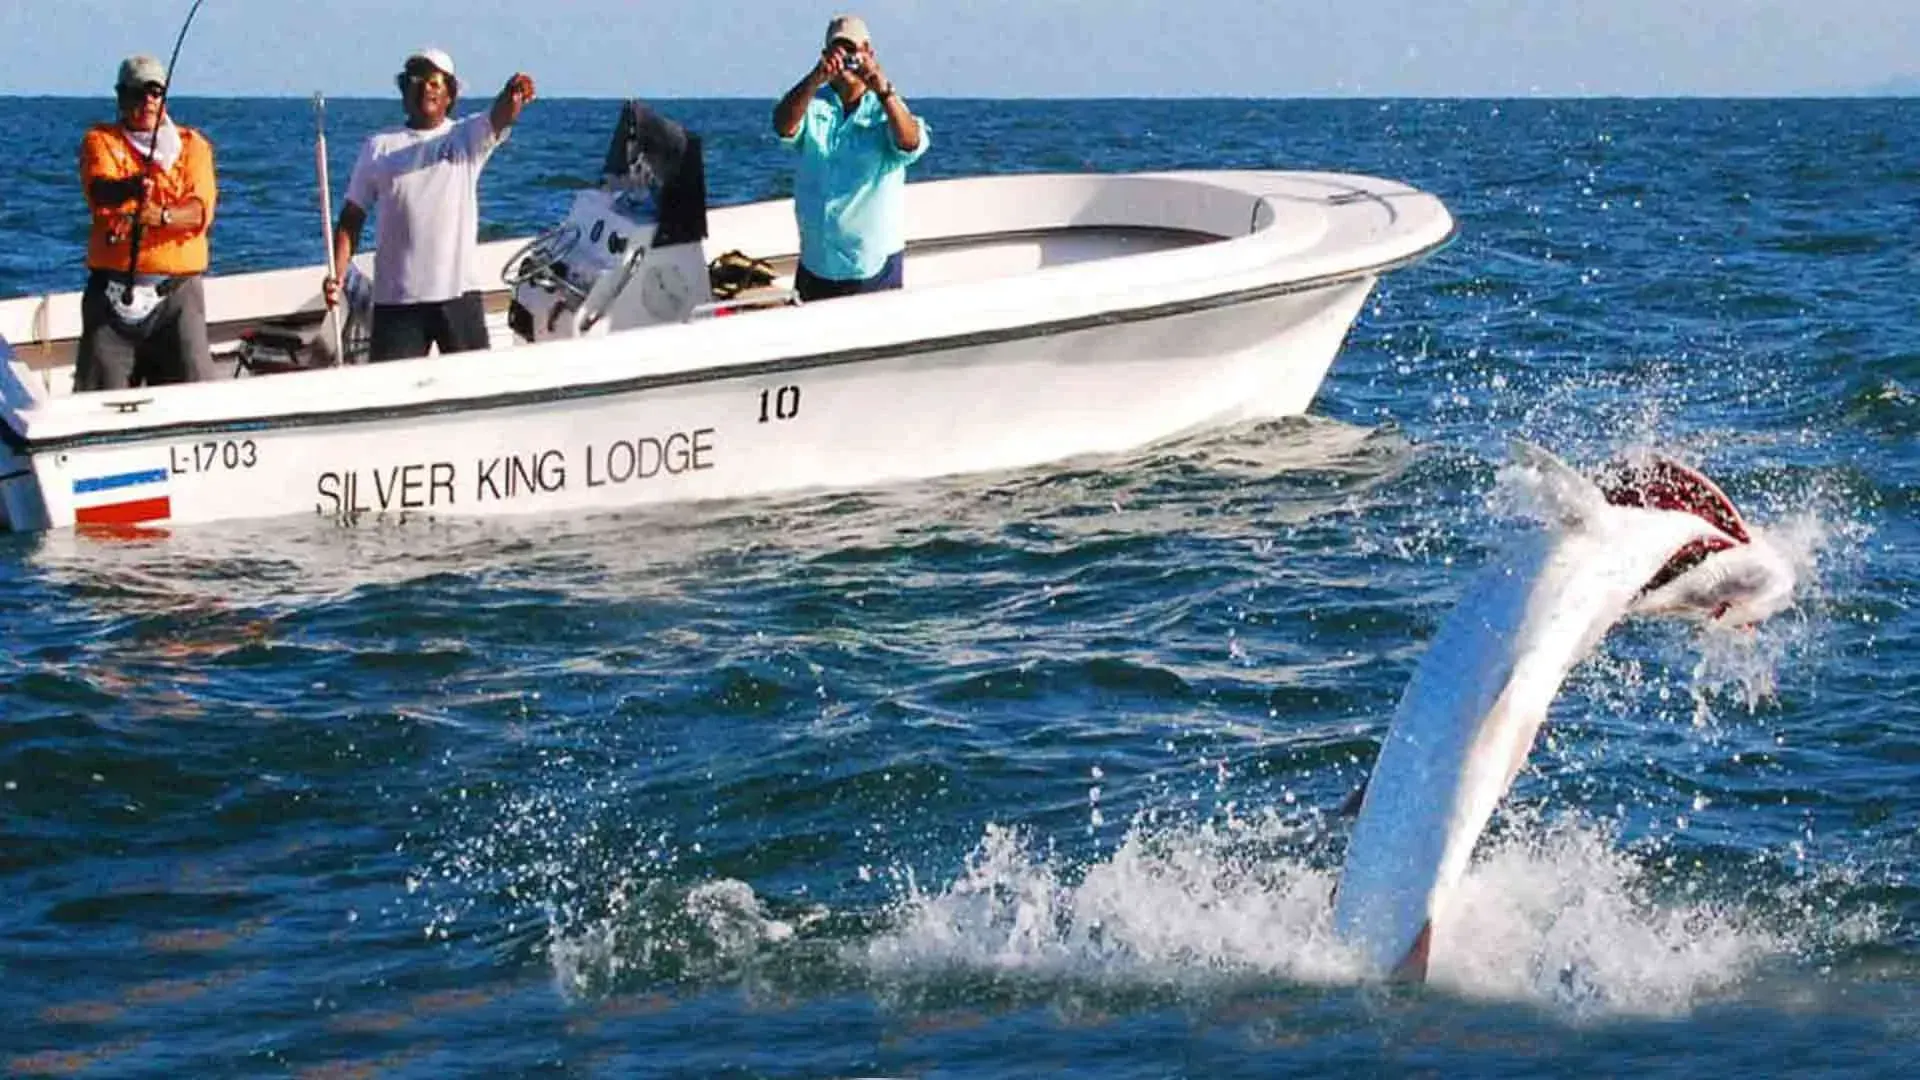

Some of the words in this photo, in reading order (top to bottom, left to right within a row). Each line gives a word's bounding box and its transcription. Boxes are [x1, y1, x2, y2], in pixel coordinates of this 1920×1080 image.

[758, 386, 800, 422] 10
[170, 440, 257, 474] L-1703
[316, 463, 456, 514] SILVER
[477, 449, 565, 501] KING
[586, 428, 714, 487] LODGE
